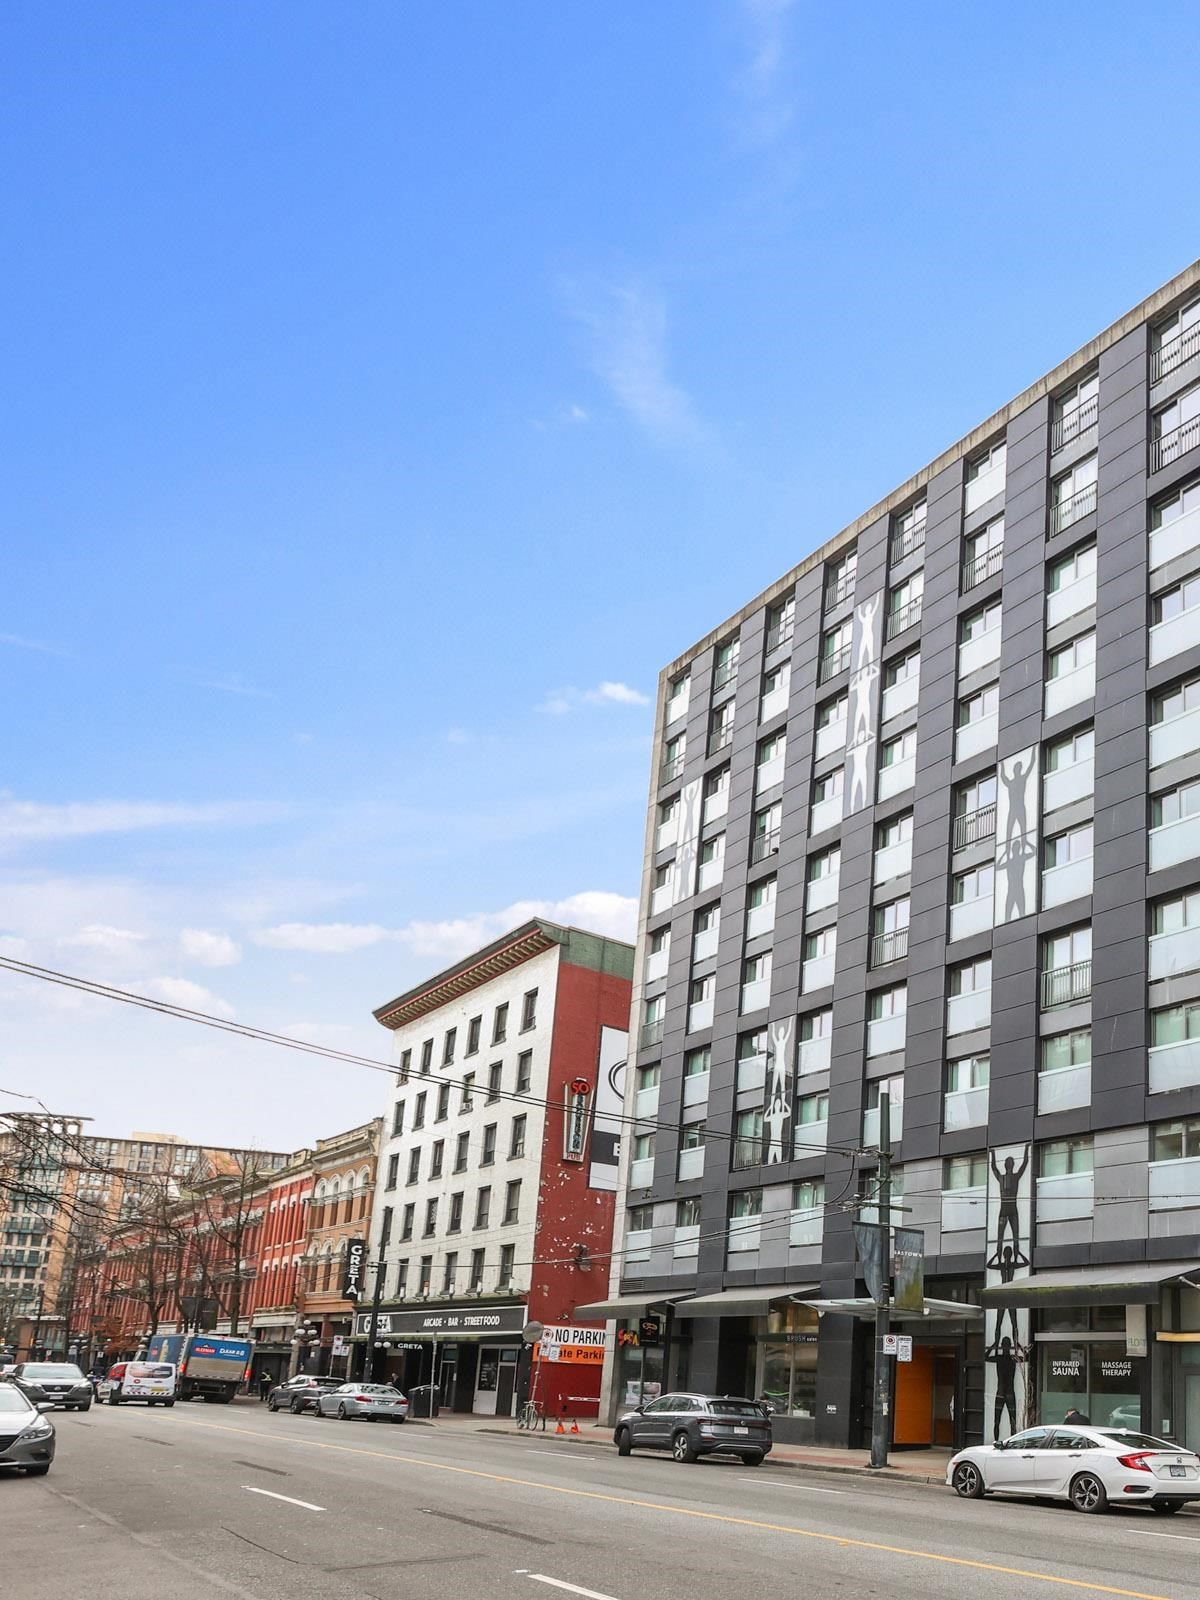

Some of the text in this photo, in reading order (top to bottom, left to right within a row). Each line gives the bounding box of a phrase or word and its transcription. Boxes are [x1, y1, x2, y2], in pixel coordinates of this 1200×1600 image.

[346, 1245, 362, 1294] GRETA
[423, 1318, 442, 1327] ARCADE
[447, 1318, 458, 1327] BAR
[555, 1329, 569, 1343] NO
[397, 1342, 423, 1350] GRETA
[1052, 1368, 1080, 1376] SAUNA
